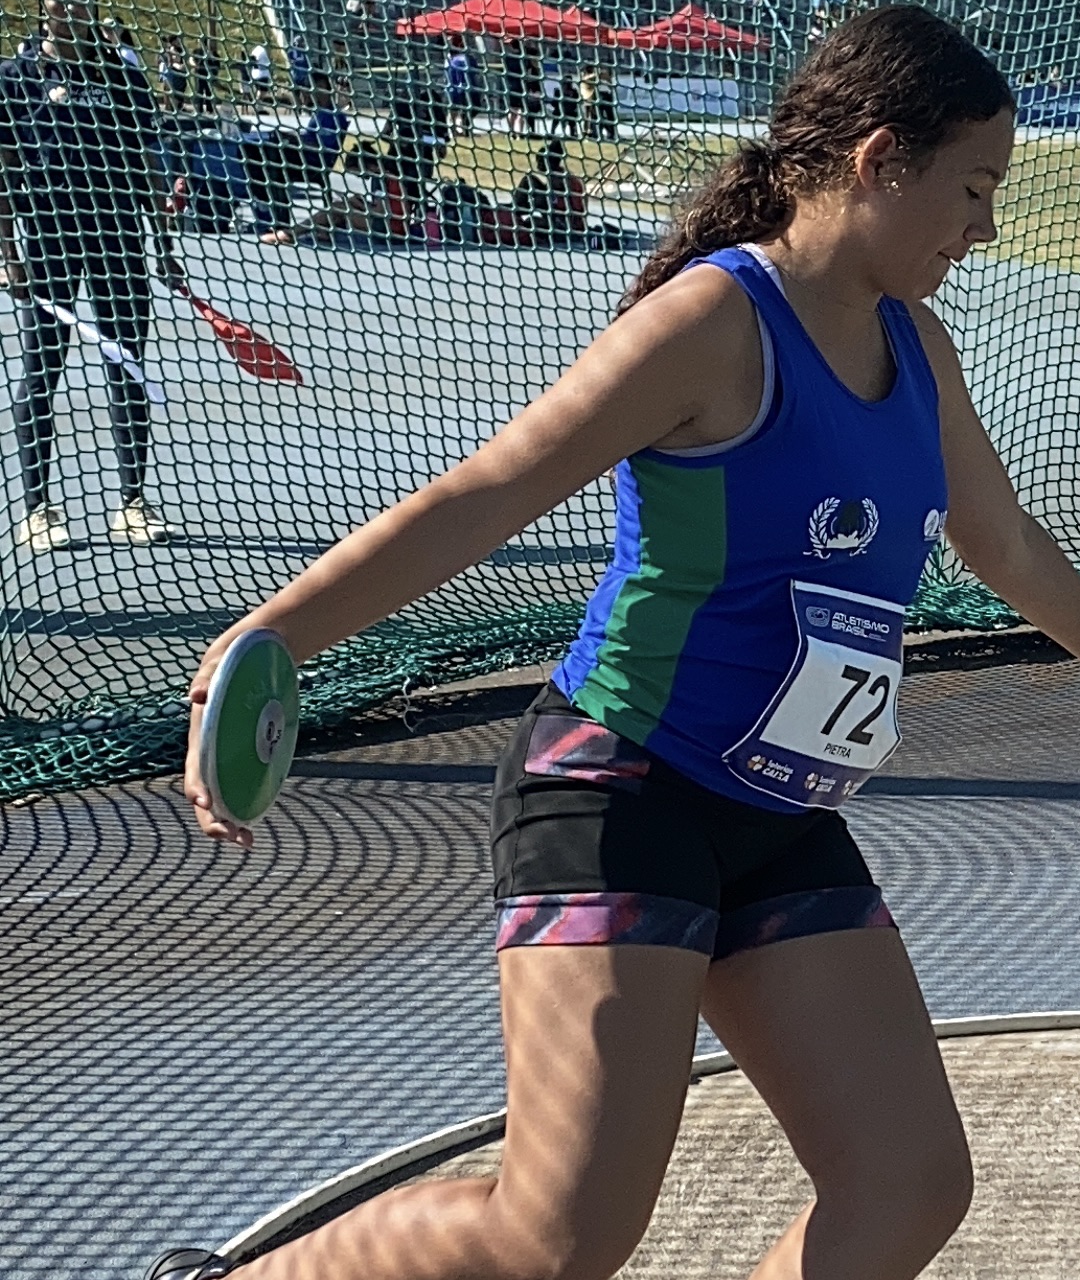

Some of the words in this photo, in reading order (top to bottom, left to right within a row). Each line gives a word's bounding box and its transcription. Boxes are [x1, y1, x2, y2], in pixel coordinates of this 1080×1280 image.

[831, 620, 868, 638] BRASIL
[832, 612, 890, 634] ATLETISMO
[820, 664, 890, 746] 72
[824, 742, 851, 758] PIETRA
[762, 767, 790, 783] CAIXA
